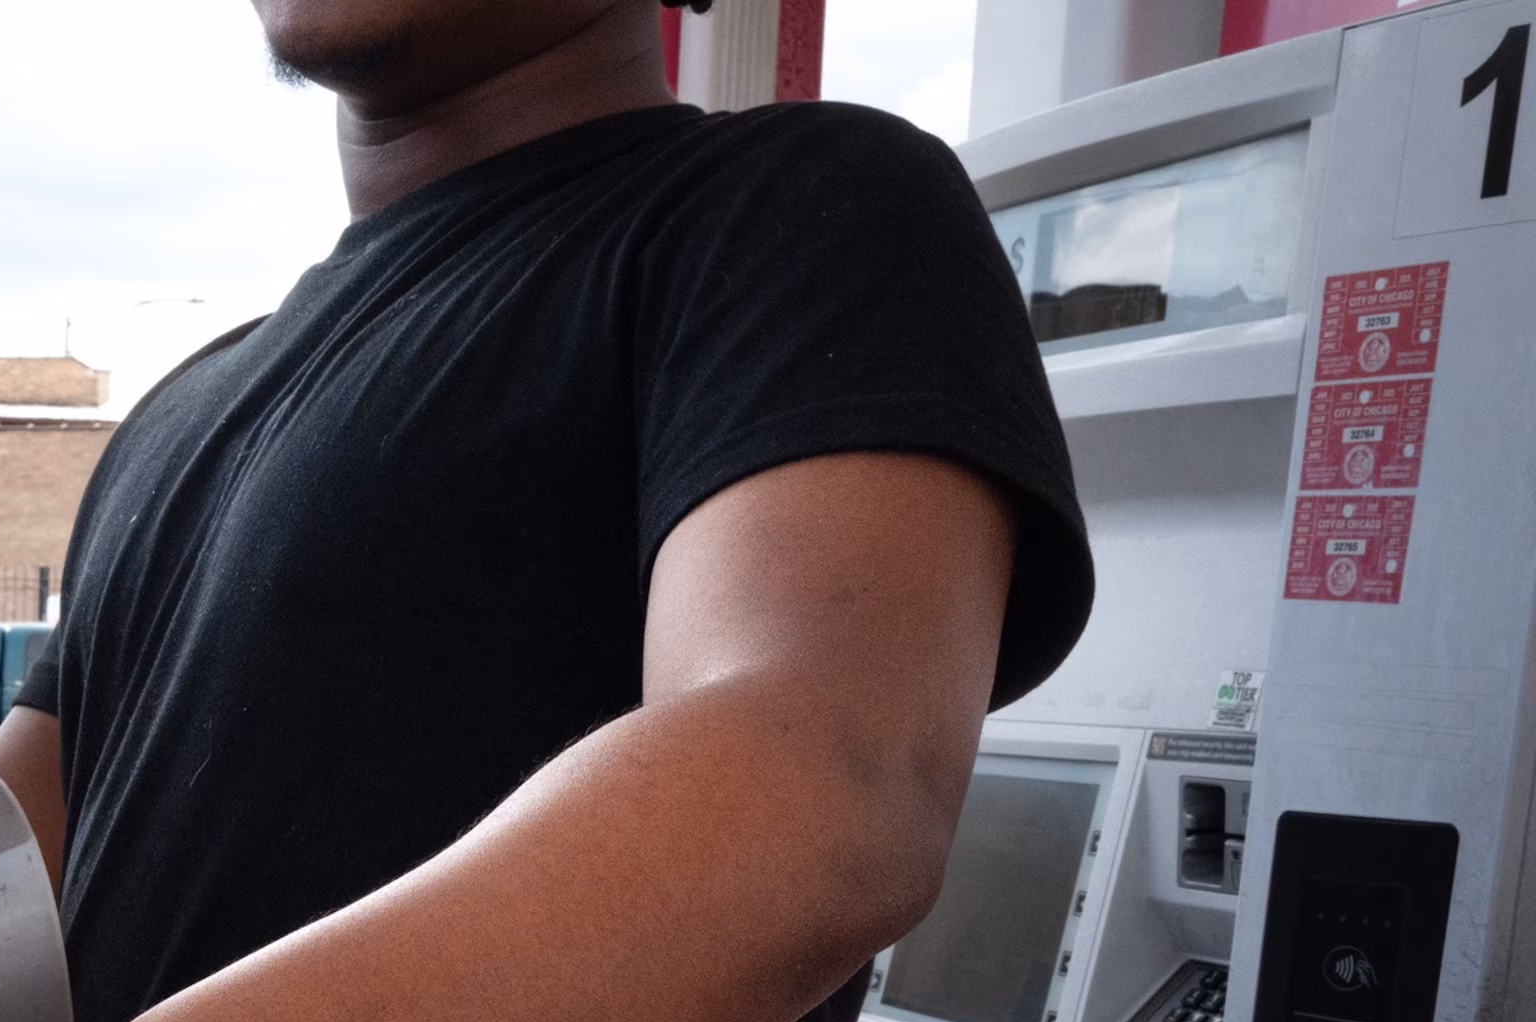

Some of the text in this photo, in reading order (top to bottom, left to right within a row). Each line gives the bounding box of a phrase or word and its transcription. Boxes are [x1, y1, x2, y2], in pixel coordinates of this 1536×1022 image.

[1460, 23, 1531, 200] 1
[1347, 289, 1414, 307] CITY OF CHICAGO
[1364, 315, 1391, 328] 32763
[1333, 403, 1398, 418] CITY OF CHICAGO
[1349, 428, 1375, 439] 32764
[1317, 519, 1381, 528] CITY OF CHICAGO
[1231, 671, 1252, 686] TOP
[1235, 687, 1258, 702] TIER
